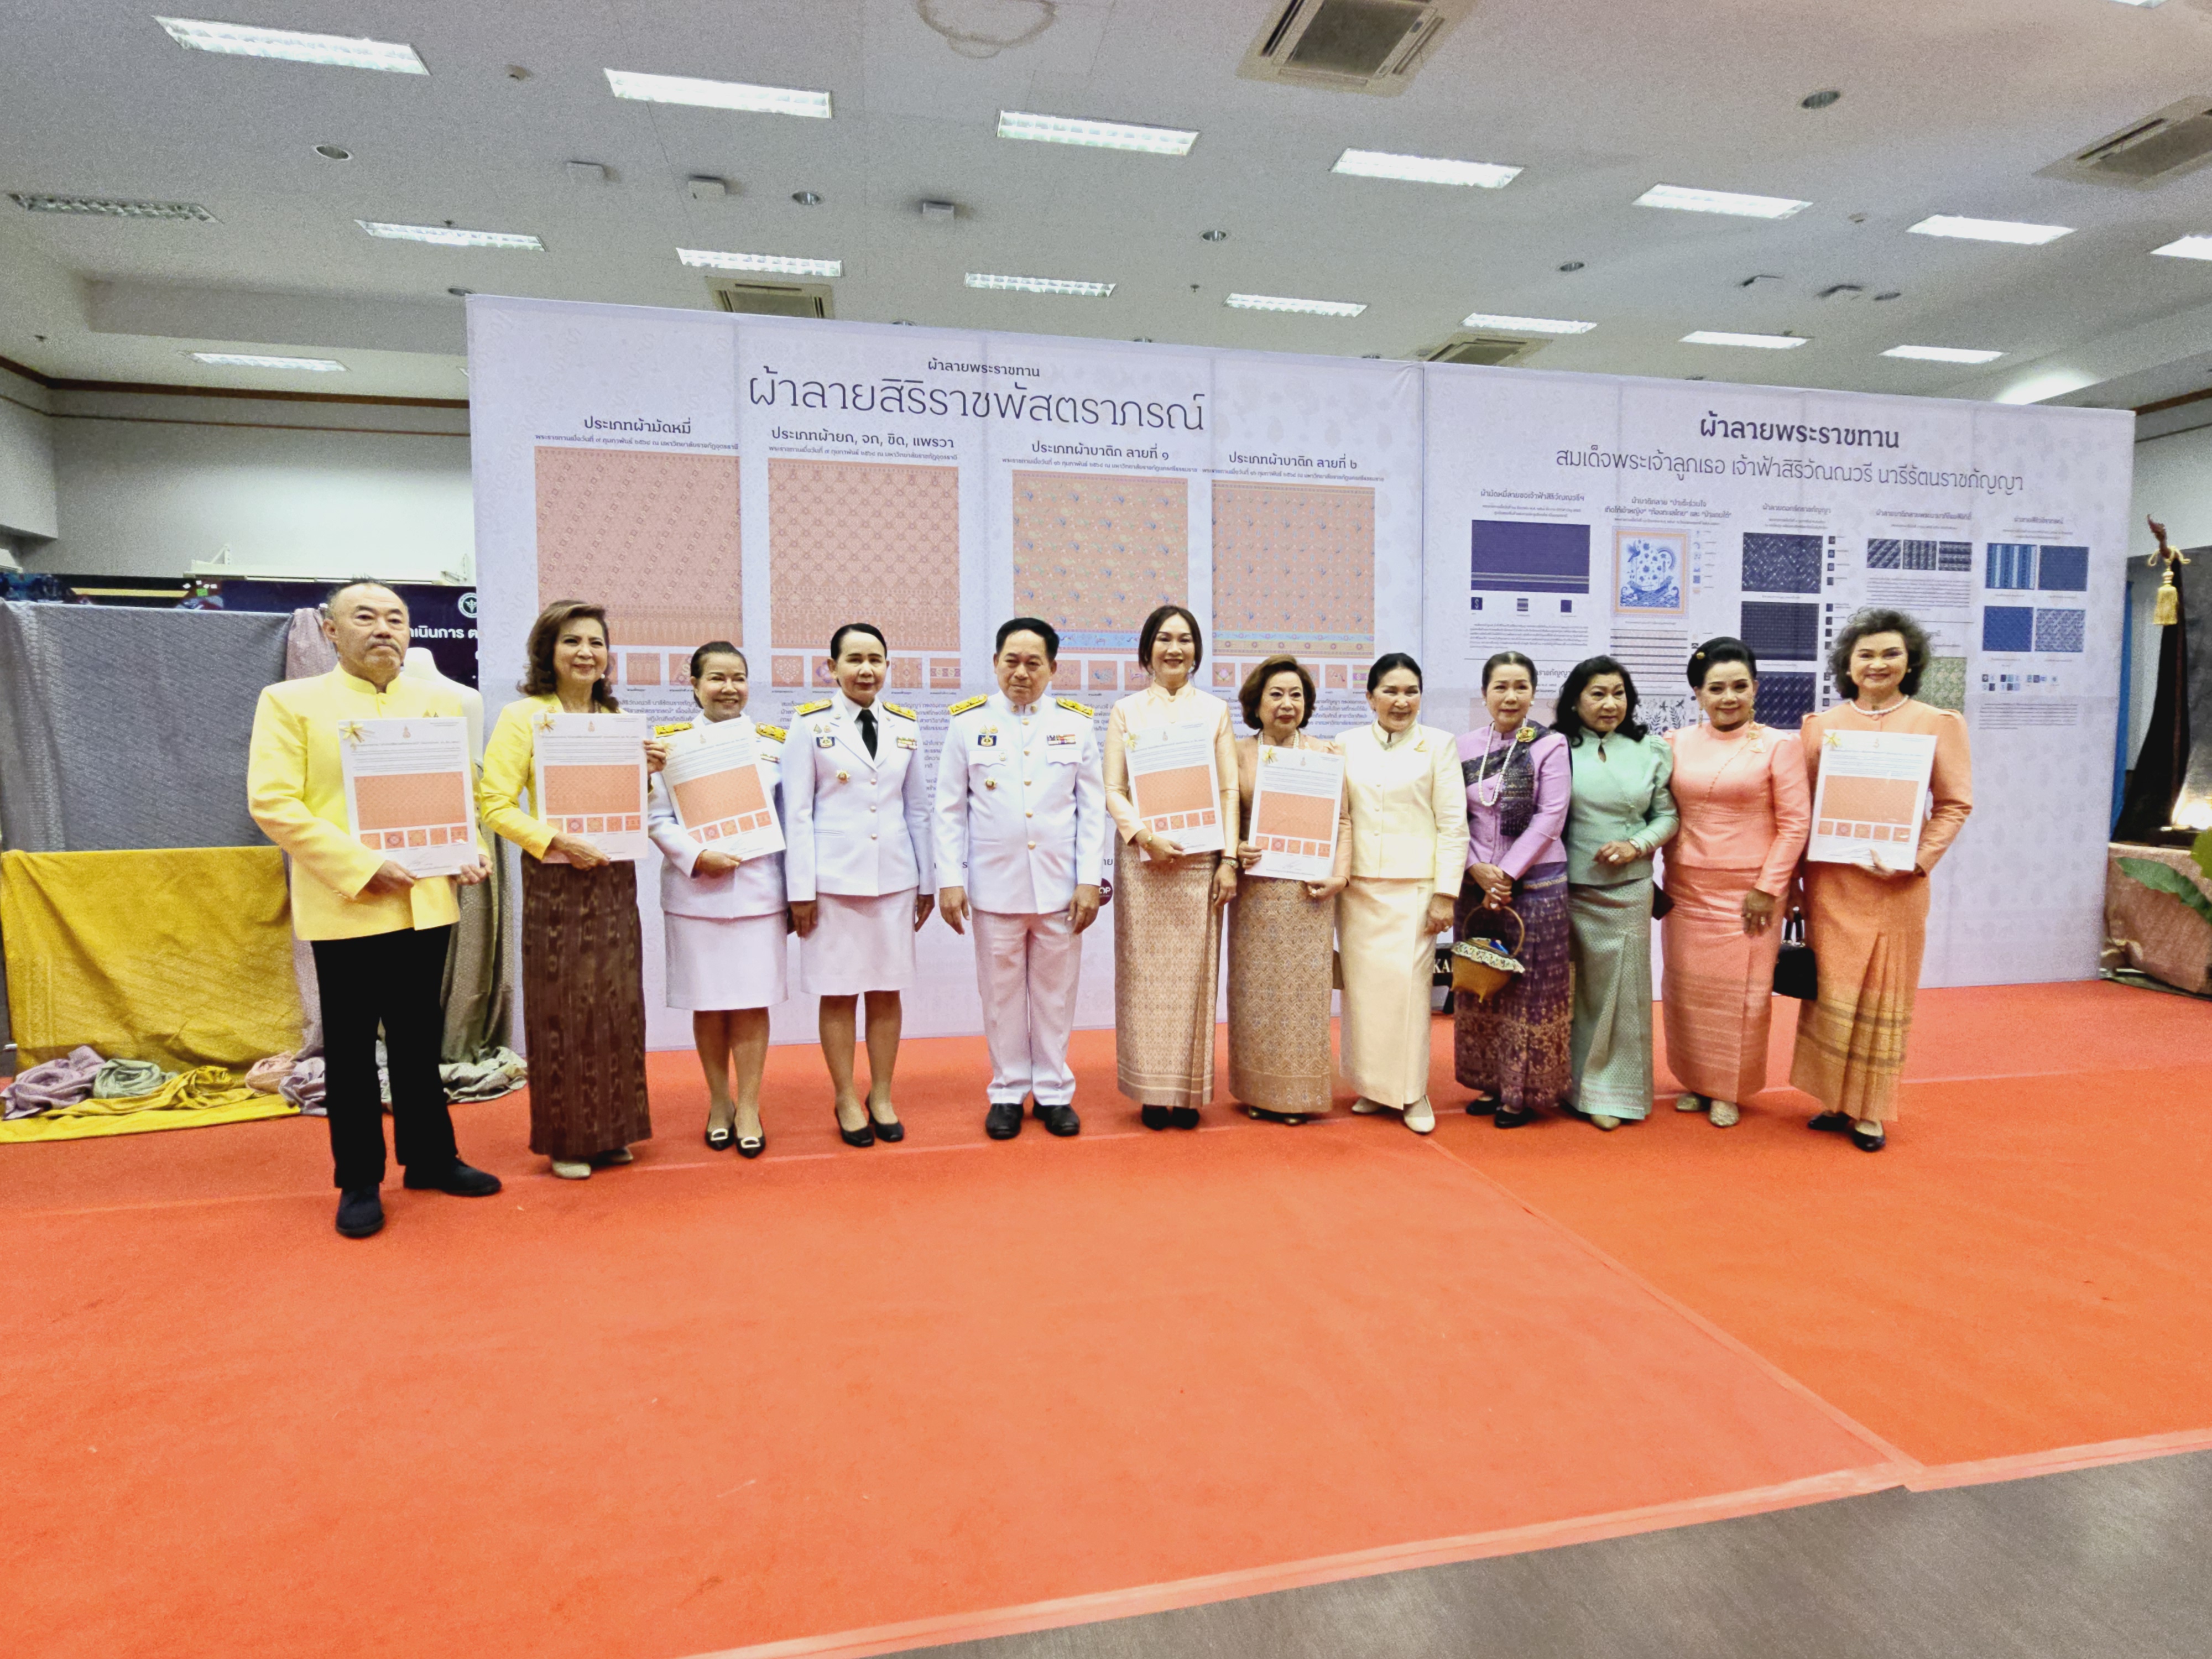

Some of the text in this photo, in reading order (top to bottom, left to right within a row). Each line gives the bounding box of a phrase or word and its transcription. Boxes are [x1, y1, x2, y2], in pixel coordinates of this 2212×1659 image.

[927, 357, 1041, 378] ผ้าลายพระราชทาน
[749, 365, 1206, 431] ผ้าลายสิริราชพัสตราภรณ์
[583, 415, 691, 434] ประเภทผ้ามัดหมี่
[1700, 411, 1901, 449] ผ้าลายพระราชทาน
[912, 436, 954, 448] แพรวา
[1031, 440, 1169, 461] ประเภทผ้าบาติก ลายที่ ๑
[1229, 451, 1313, 467] ประเภทผ้าบาติก
[1317, 453, 1347, 469] ลายที่
[1556, 444, 2024, 496] สมเด็จพระเจ้าลูกเธอ เจ้าฟ้าสิริวัณณวรี นารีรัตนราชกัญญา
